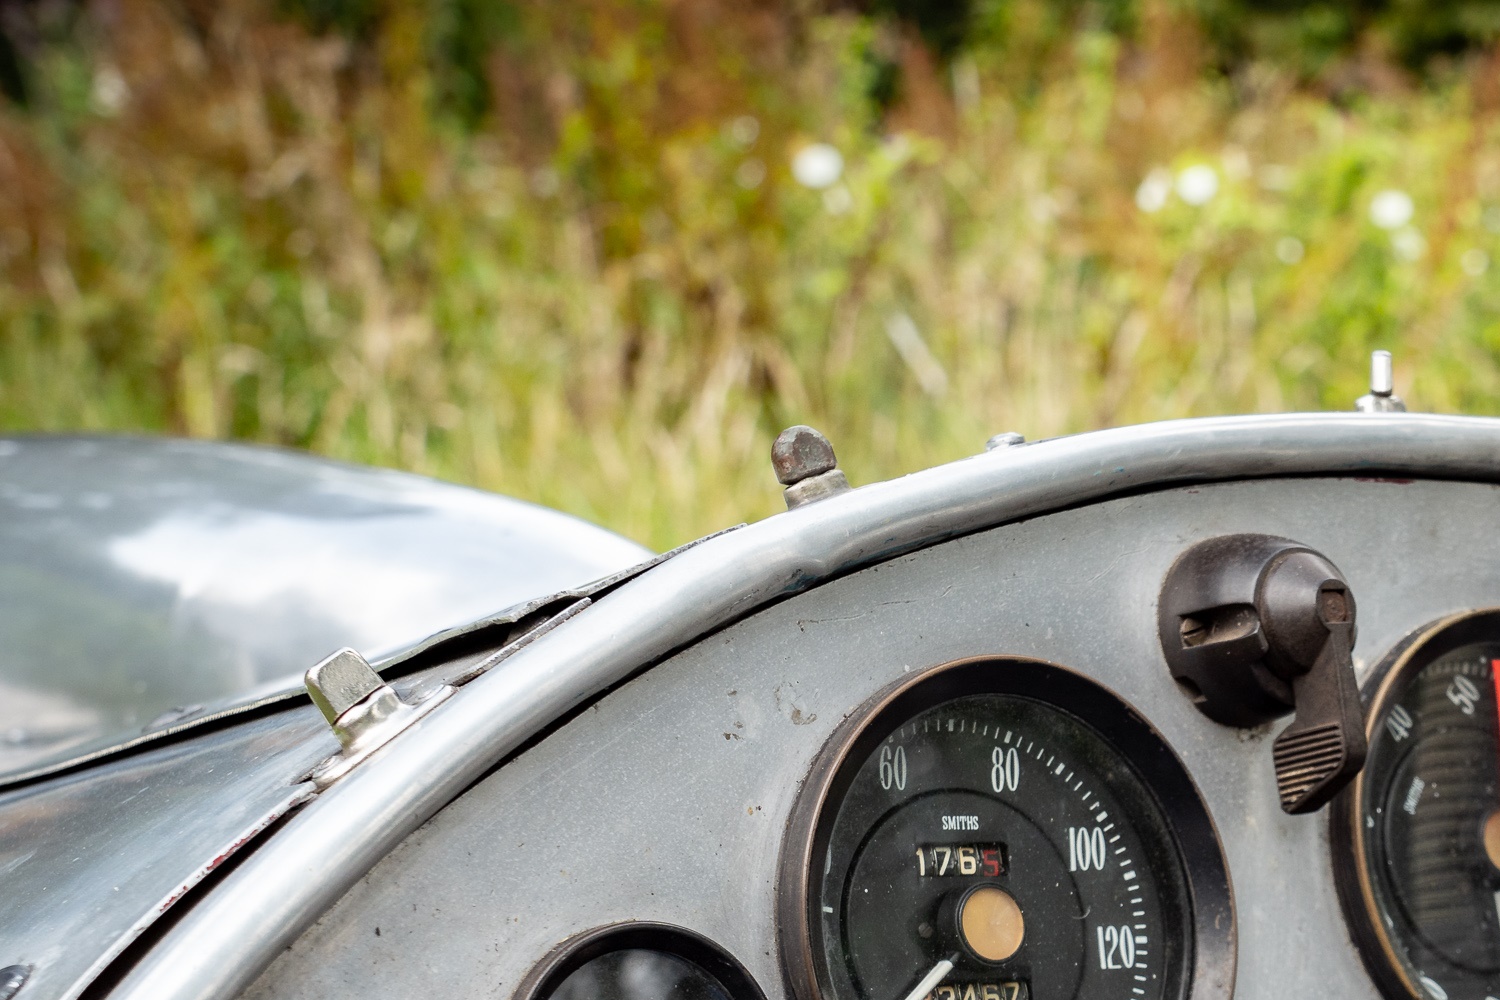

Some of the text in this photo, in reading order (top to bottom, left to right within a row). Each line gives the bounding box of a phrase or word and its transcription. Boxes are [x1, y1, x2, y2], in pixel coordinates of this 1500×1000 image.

[1446, 674, 1480, 715] 50
[1387, 704, 1413, 742] 40
[879, 745, 907, 791] 60
[991, 747, 1019, 792] 80
[942, 816, 979, 830] SMITHS
[916, 847, 1000, 877] 1765
[1069, 827, 1106, 872] 100
[1097, 926, 1134, 969] 120
